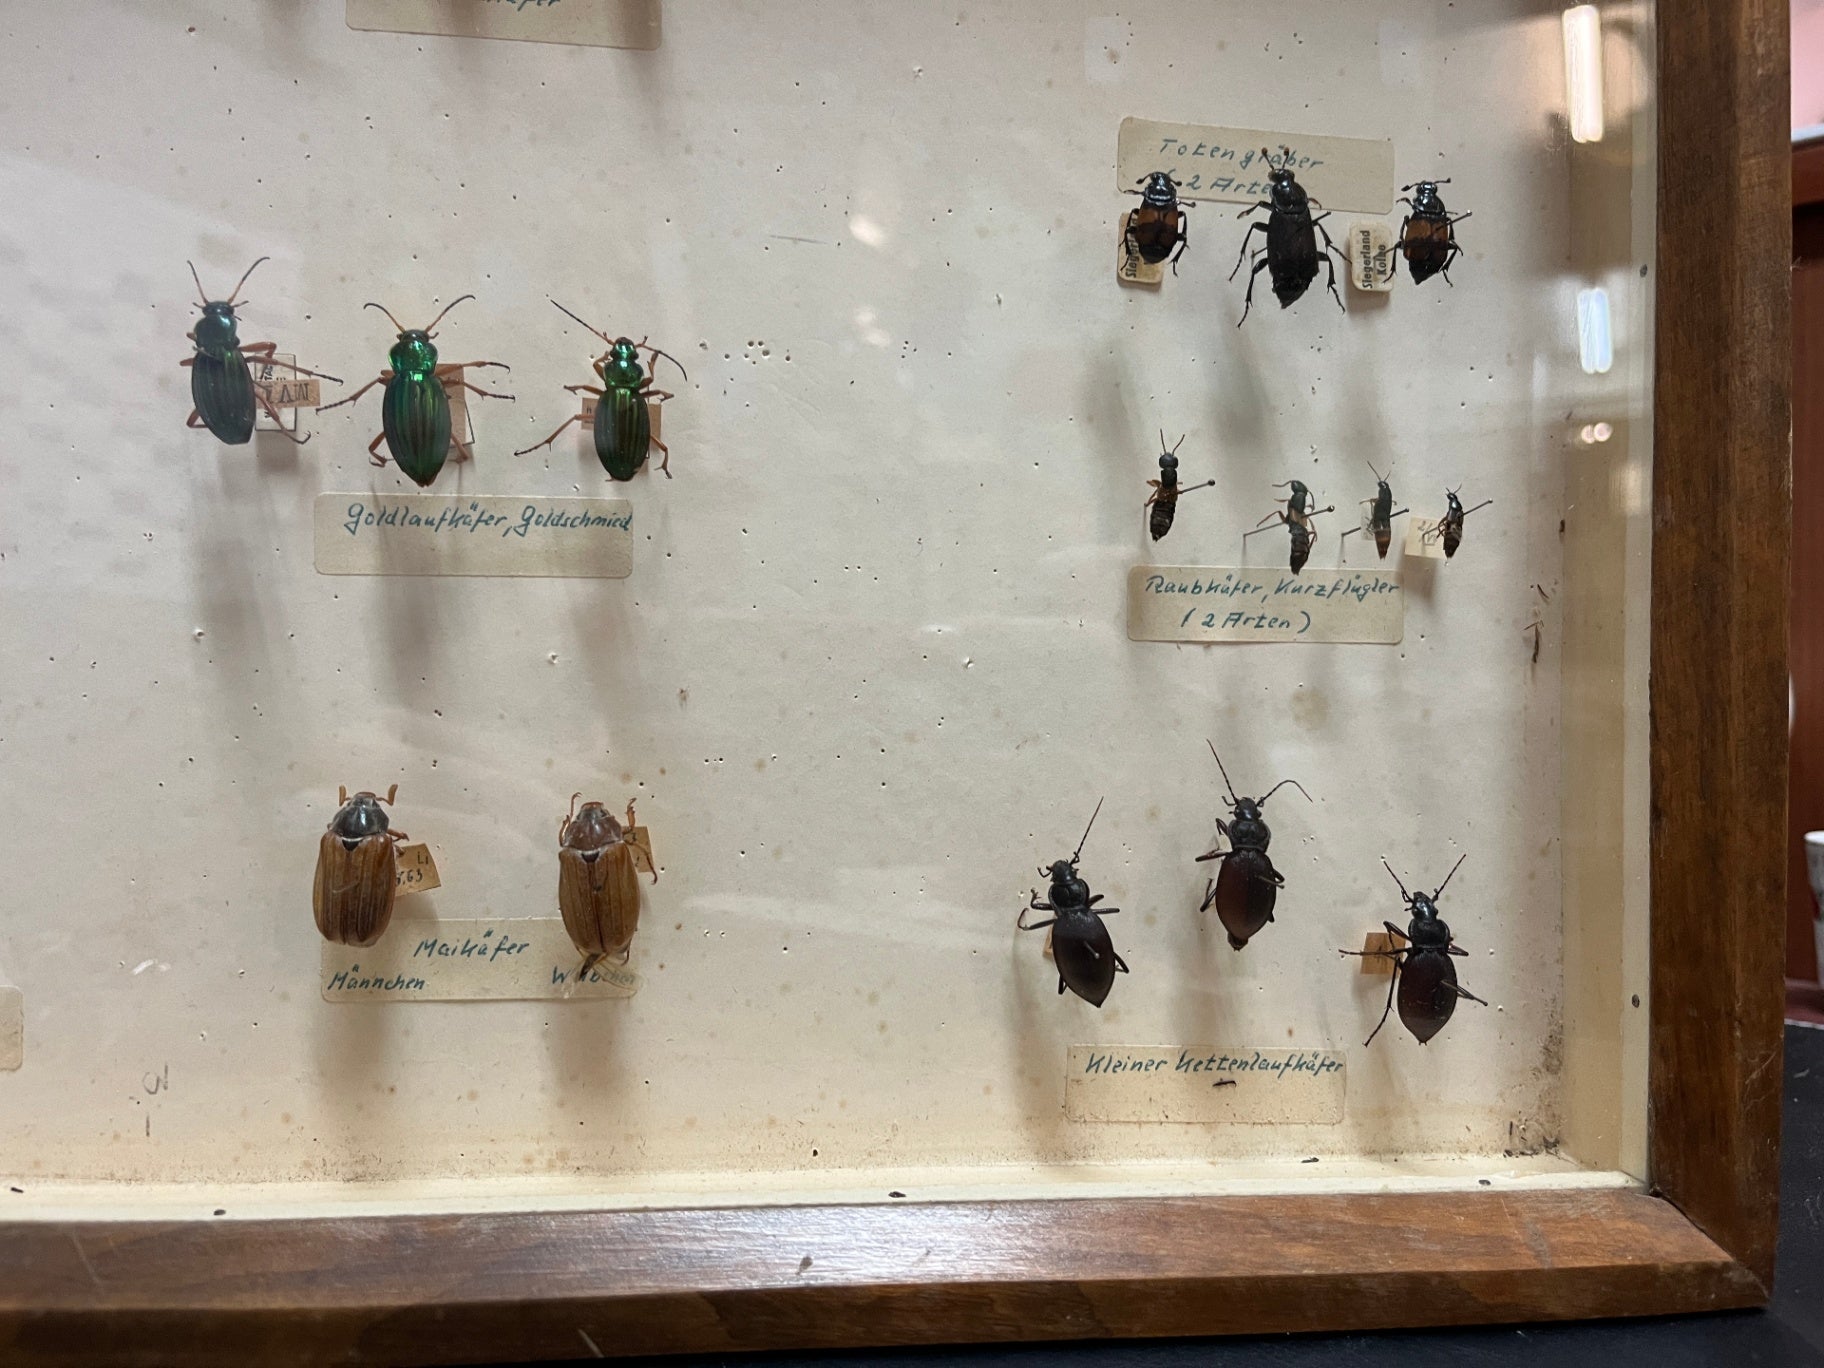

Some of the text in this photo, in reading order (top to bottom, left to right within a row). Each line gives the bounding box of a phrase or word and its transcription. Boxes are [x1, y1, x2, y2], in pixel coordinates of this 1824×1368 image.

[1209, 176, 1273, 194] Arte
[1361, 230, 1373, 289] Siegerland
[413, 927, 530, 961] Maikäfer
[327, 963, 637, 991] Männchen Wbchen
[1084, 1049, 1344, 1080] Kleiner Kettenlaufkäfer
